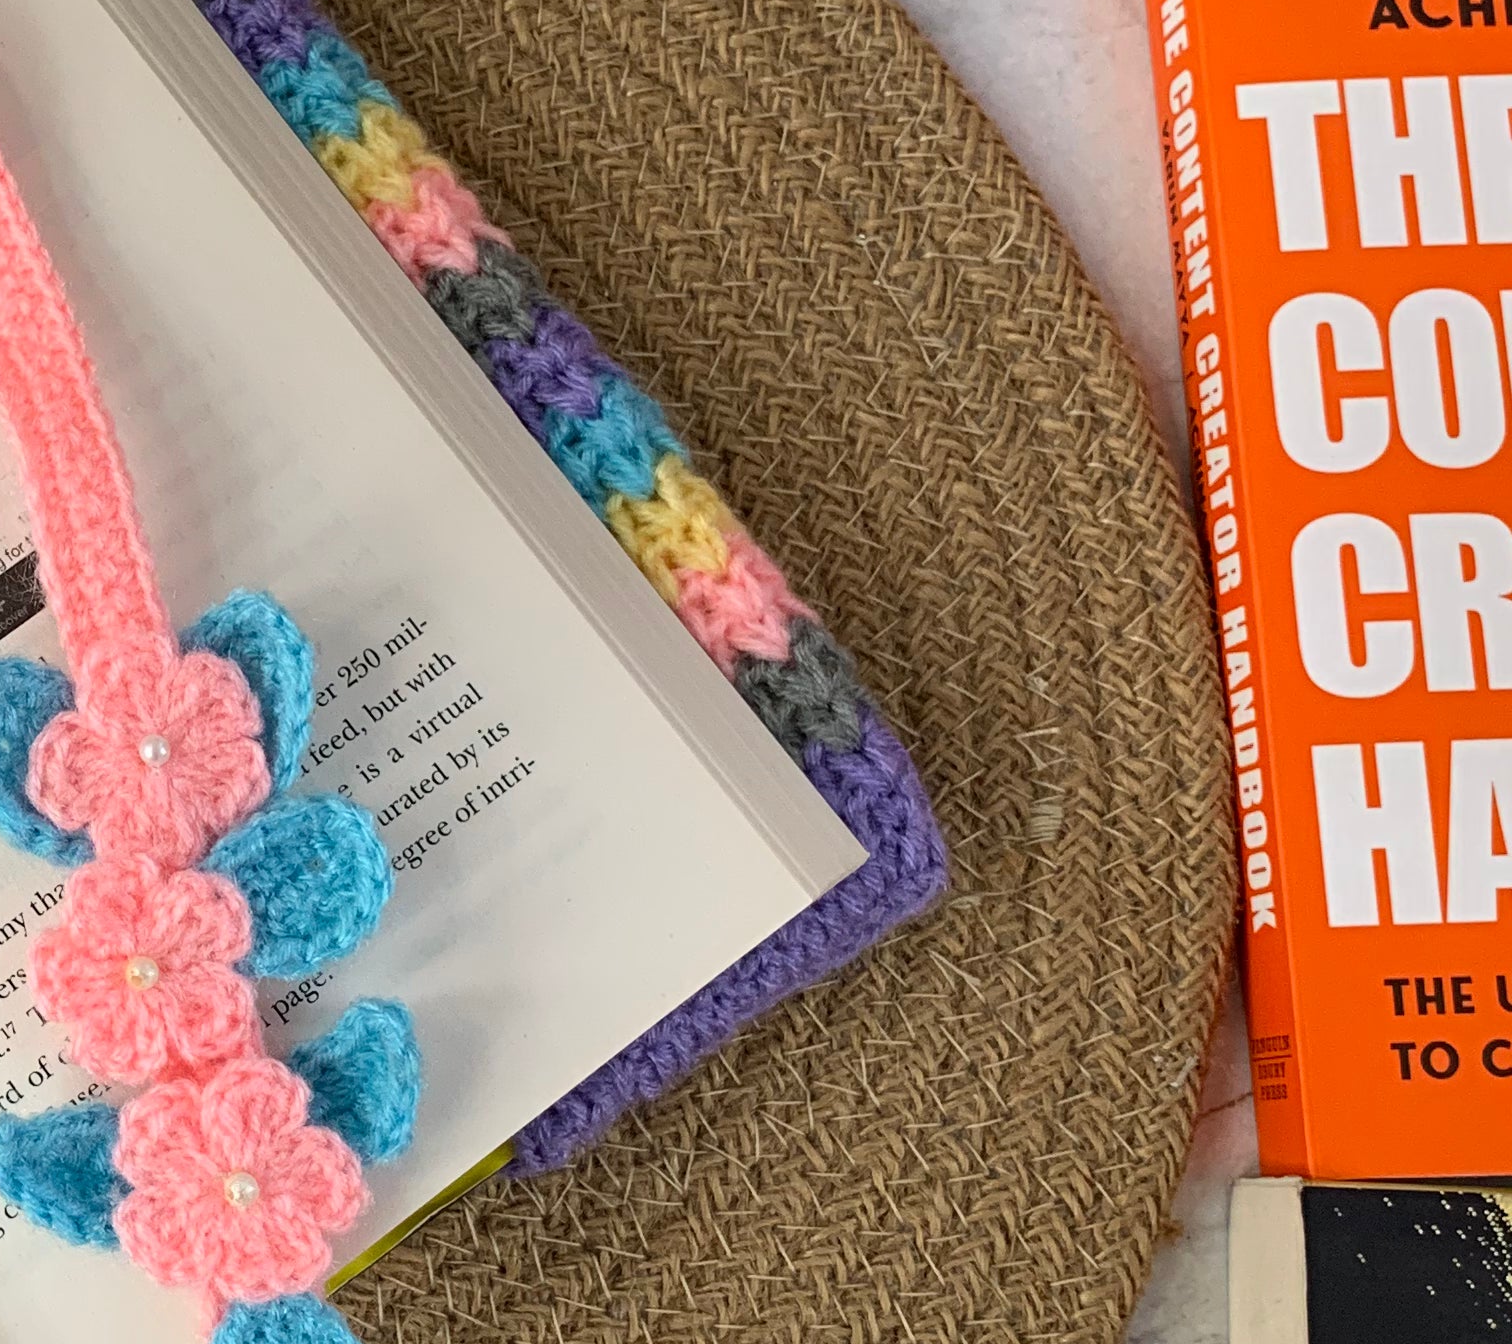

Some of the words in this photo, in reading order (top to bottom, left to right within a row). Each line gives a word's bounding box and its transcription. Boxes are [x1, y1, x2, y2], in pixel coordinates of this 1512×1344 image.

[1267, 286, 1512, 474] CO
[1169, 69, 1217, 319] CONTENT
[1195, 332, 1243, 596] CREATOR
[1222, 605, 1277, 934] HANDBOOK
[337, 648, 381, 688] 250
[383, 617, 427, 656] mil-
[308, 718, 367, 766] feed,
[361, 688, 407, 723] but
[404, 652, 457, 693] with
[1383, 975, 1476, 1016] THE
[1390, 1040, 1460, 1081] TO
